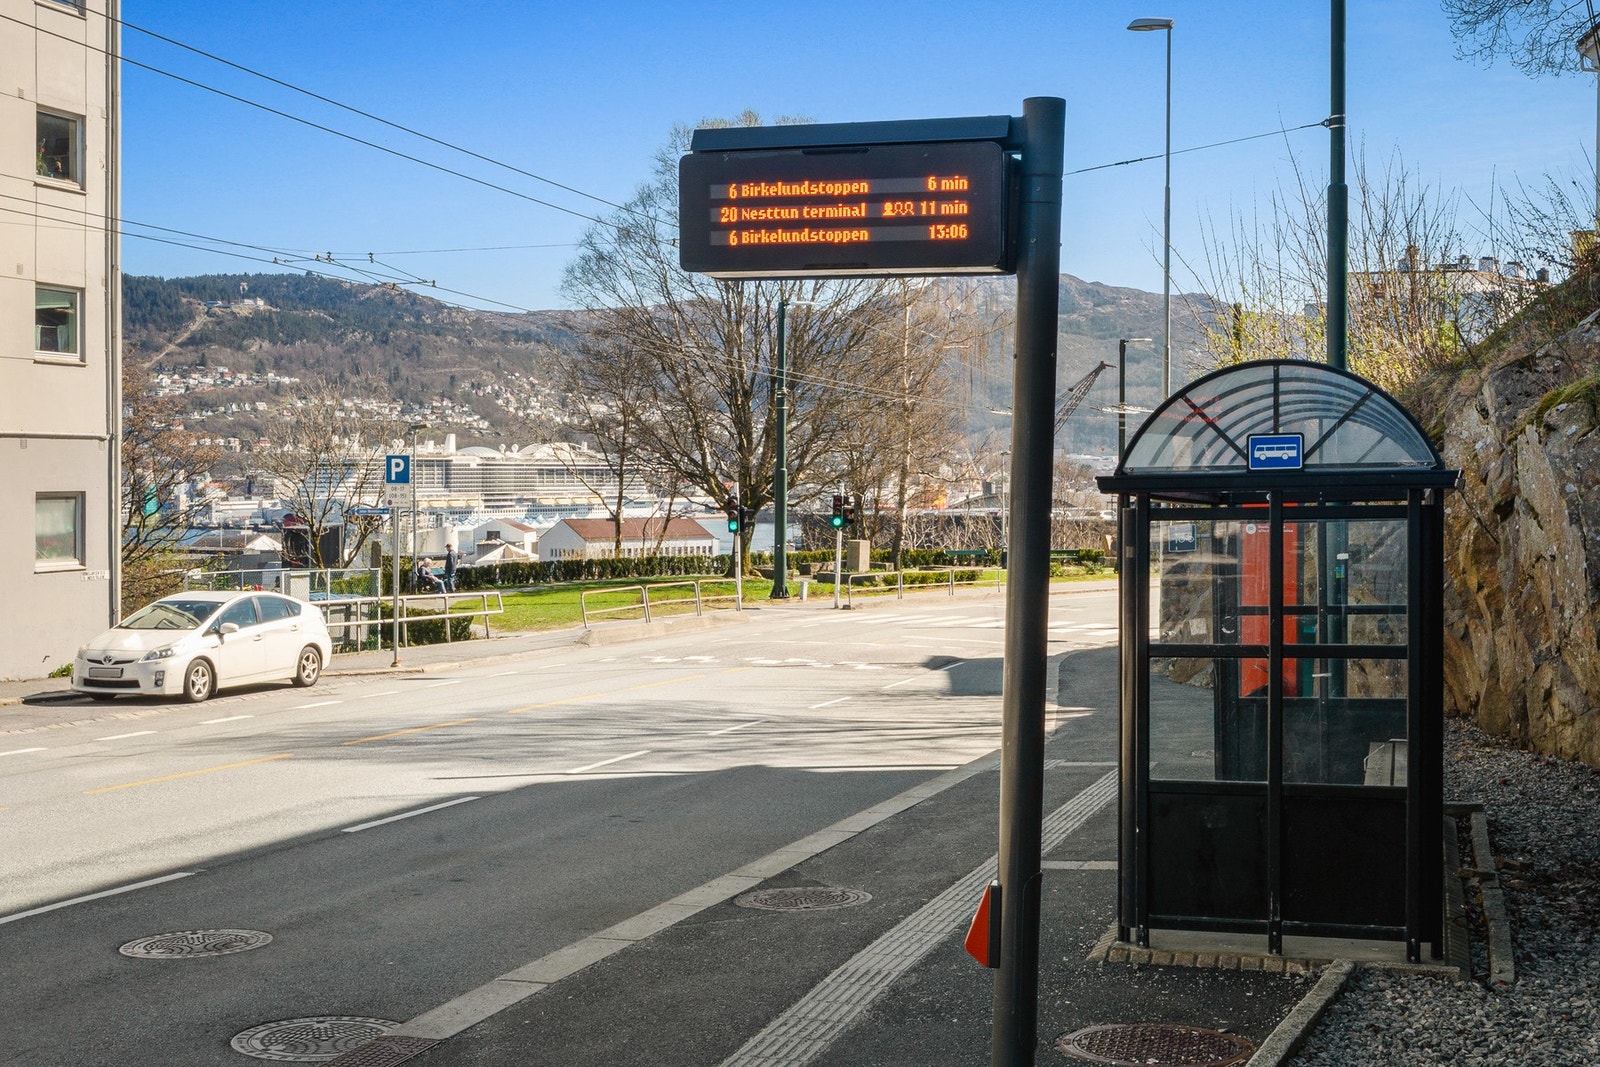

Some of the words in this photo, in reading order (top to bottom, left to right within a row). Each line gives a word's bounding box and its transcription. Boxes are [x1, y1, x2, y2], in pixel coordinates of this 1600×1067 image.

[728, 183, 738, 199] 6
[741, 180, 869, 197] Birkelundstoppen
[927, 176, 937, 191] 6
[941, 175, 968, 190] min
[720, 206, 738, 223] 20
[741, 207, 799, 221] Nesttun
[802, 202, 867, 218] terminal
[920, 200, 936, 215] 11
[941, 200, 968, 215] min
[729, 230, 738, 246] 6
[741, 228, 869, 244] Birkelundstoppen
[929, 224, 968, 239] 13:06
[391, 458, 405, 481] P
